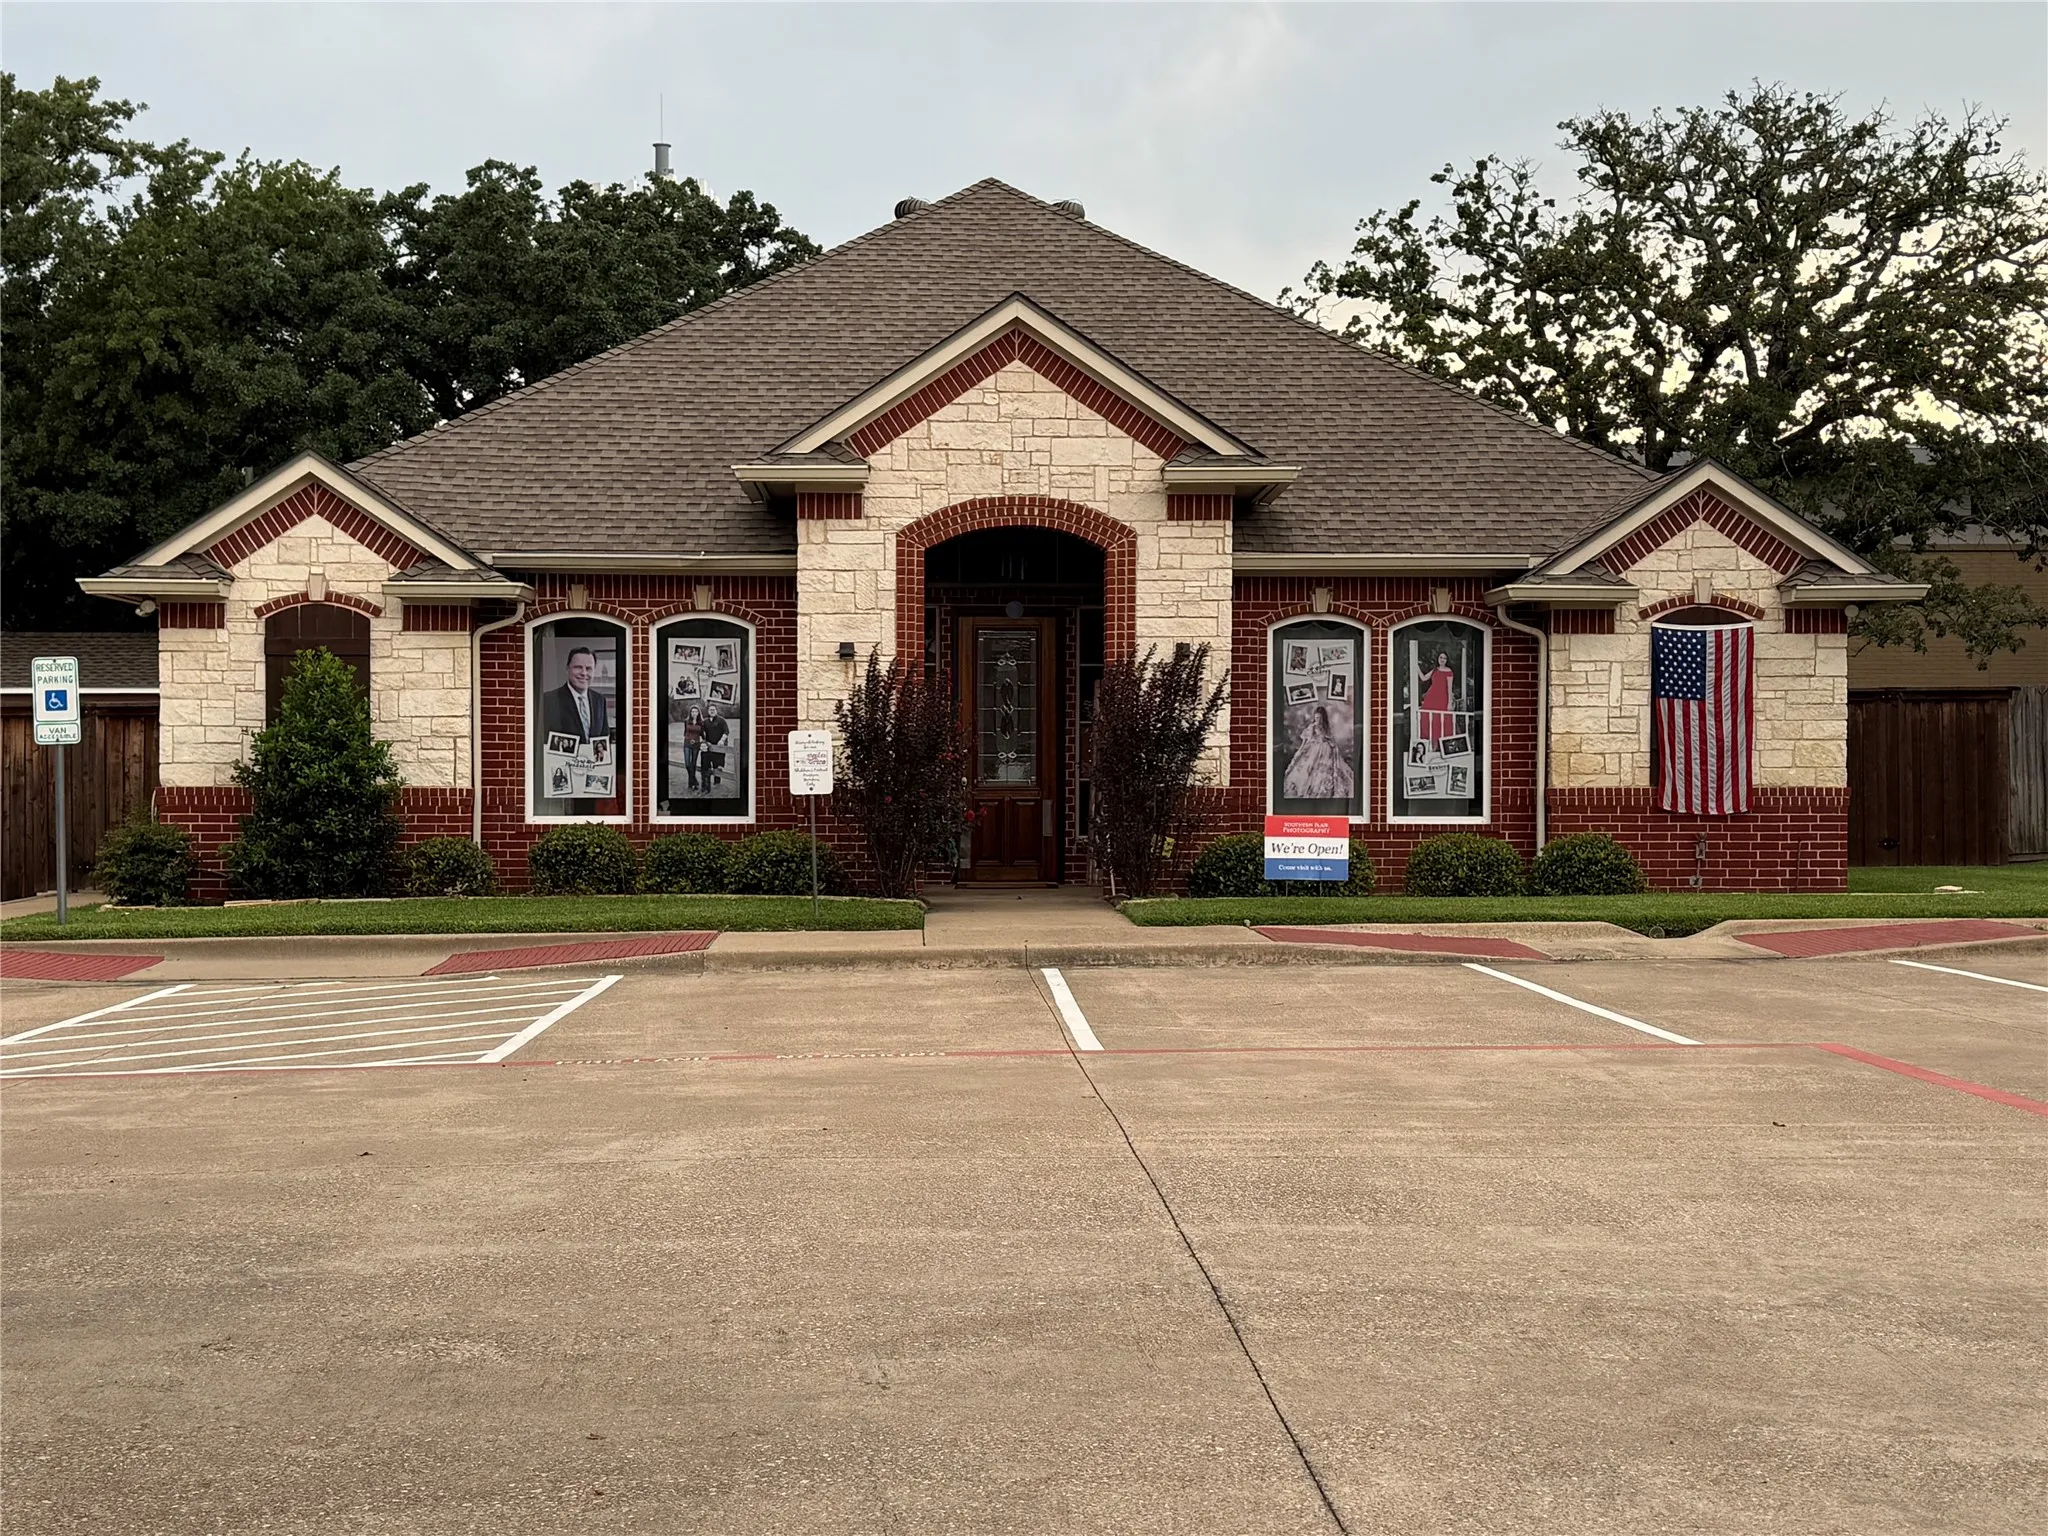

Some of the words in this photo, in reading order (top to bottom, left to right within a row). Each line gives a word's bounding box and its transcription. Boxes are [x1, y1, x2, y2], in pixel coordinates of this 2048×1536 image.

[36, 663, 73, 672] RESERVED
[37, 675, 73, 684] PARKING
[1271, 842, 1305, 854] We're
[1307, 843, 1344, 856] Open!
